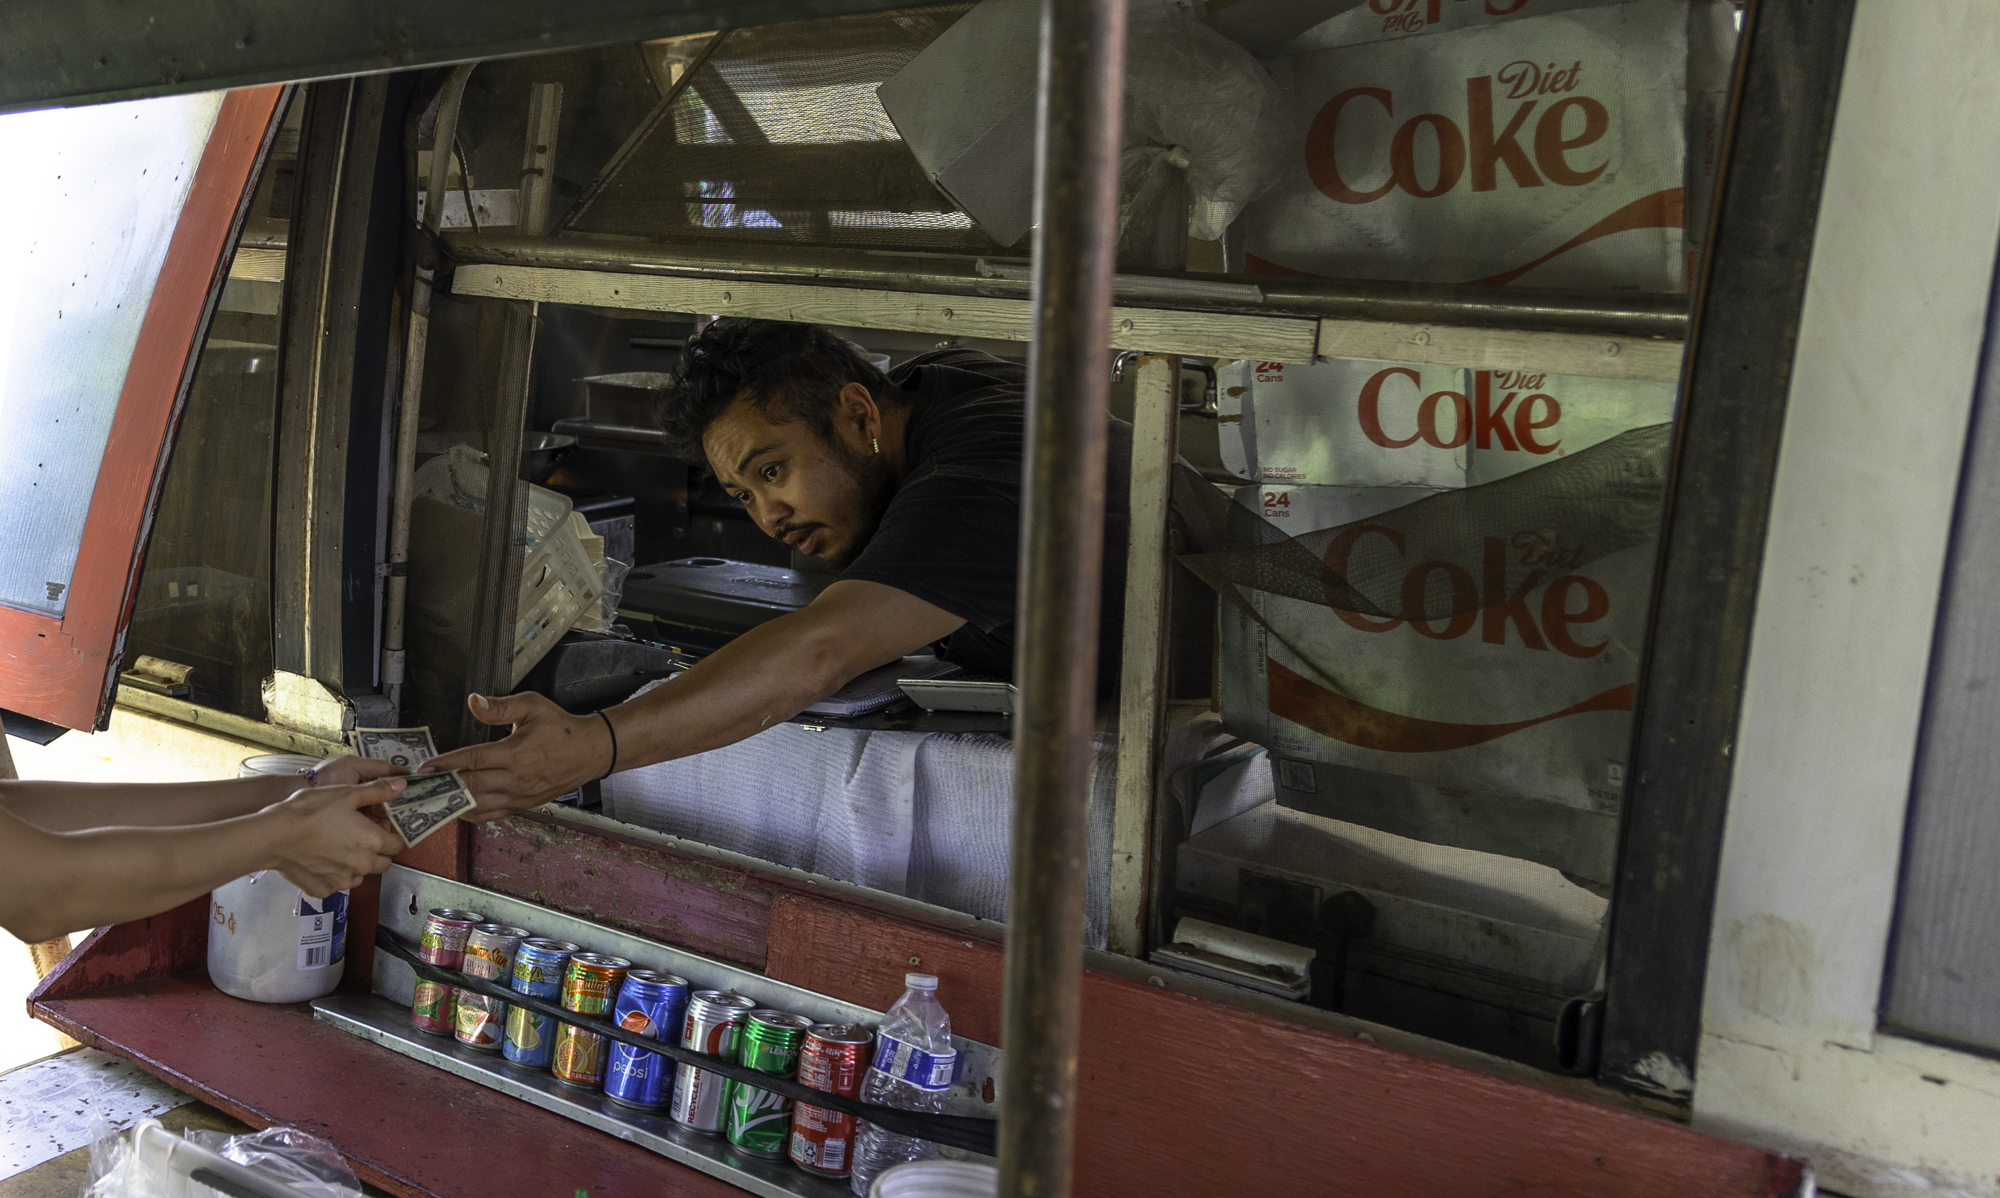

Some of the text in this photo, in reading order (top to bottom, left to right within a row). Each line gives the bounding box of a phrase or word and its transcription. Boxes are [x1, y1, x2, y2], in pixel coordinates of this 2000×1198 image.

[1382, 12, 1424, 33] Diet
[1498, 60, 1581, 99] Diet
[1305, 75, 1610, 205] Coke
[1256, 361, 1283, 373] 24
[1257, 374, 1283, 383] Cans
[1495, 370, 1546, 392] Diet
[1358, 367, 1562, 455] Coke
[1264, 492, 1290, 508] 24
[1265, 509, 1290, 518] Cans
[1511, 531, 1585, 569] Diet
[1320, 523, 1610, 658] Coke
[489, 947, 508, 968] Sun
[522, 985, 543, 999] Tea
[612, 1061, 648, 1079] pepsi
[687, 1081, 699, 1124] RECYCLE
